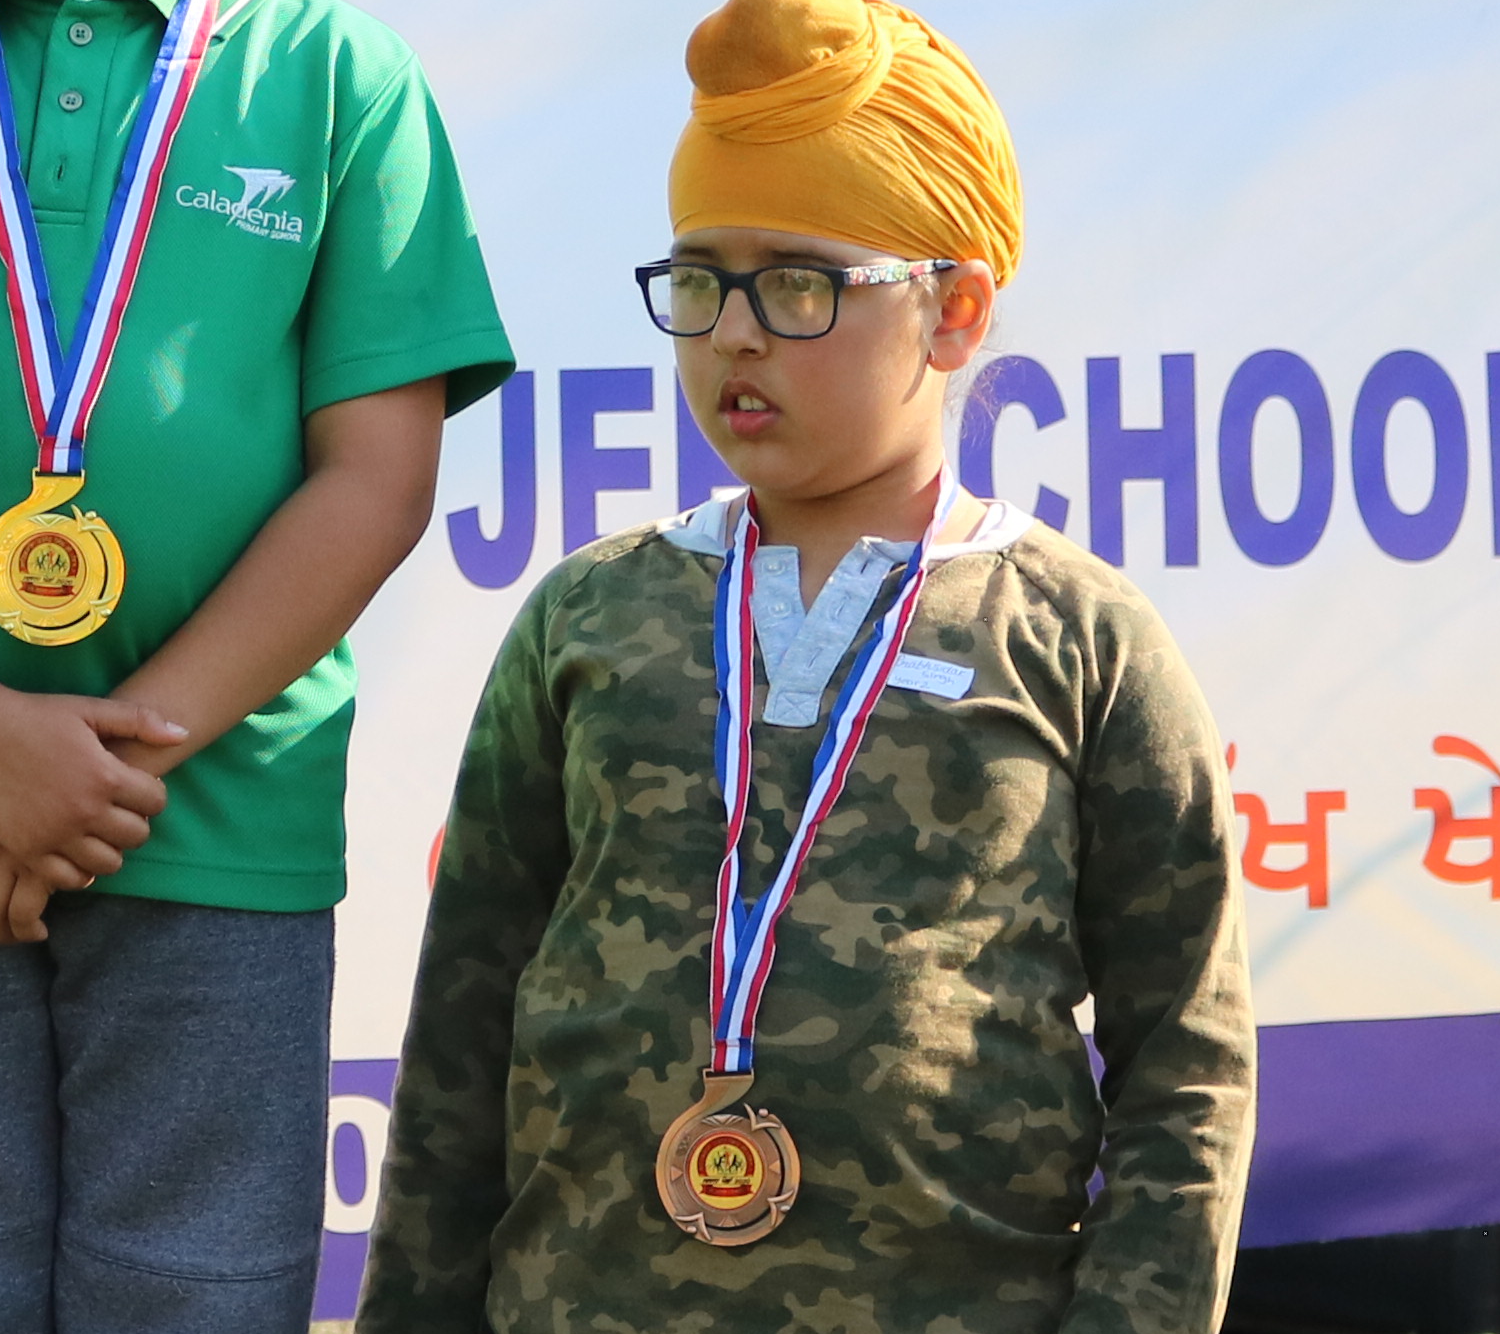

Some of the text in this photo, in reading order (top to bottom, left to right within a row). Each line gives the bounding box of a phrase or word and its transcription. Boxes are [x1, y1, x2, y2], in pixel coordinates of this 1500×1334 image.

[175, 184, 303, 233] Caladenia
[270, 229, 302, 244] SCHOOL
[446, 366, 740, 590] JE
